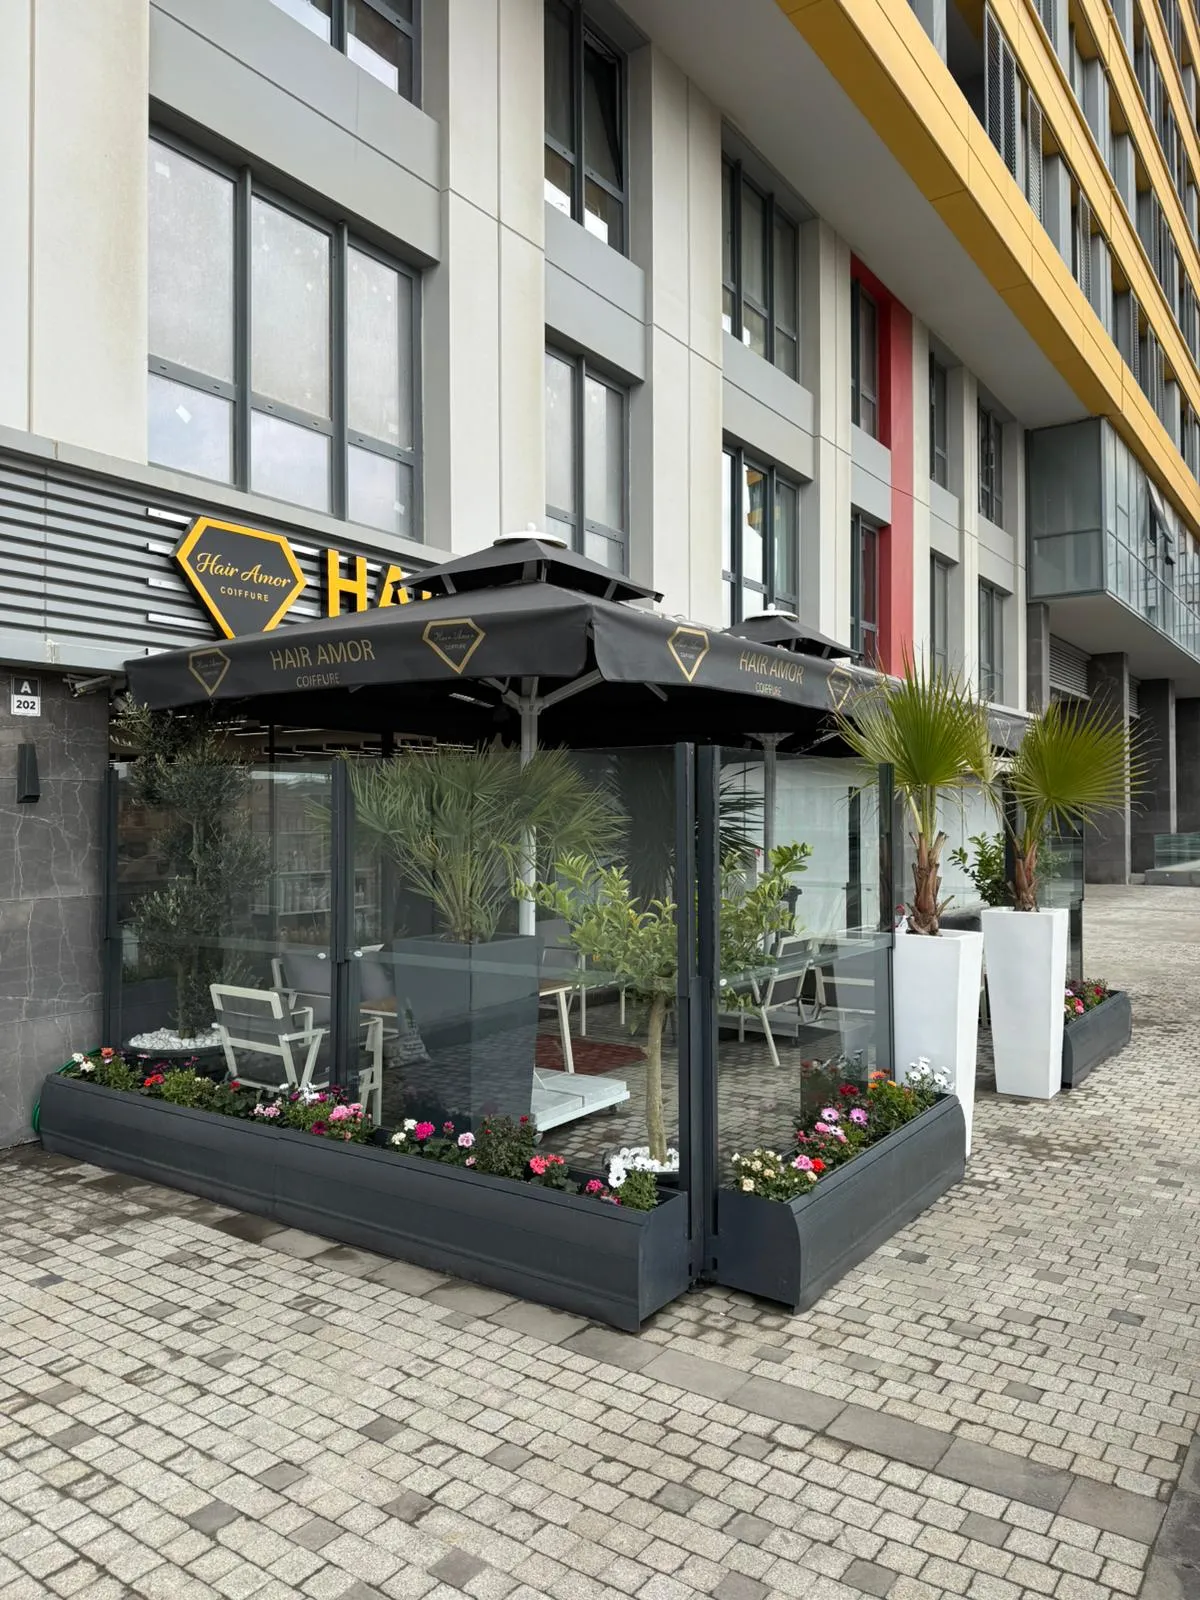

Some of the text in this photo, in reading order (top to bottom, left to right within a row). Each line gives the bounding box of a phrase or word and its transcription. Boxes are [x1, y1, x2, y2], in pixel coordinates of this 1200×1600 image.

[196, 552, 291, 588] Hair Amor
[220, 586, 269, 602] COIFFURE
[327, 548, 432, 618] HA
[269, 639, 376, 671] HAIR AMOR
[739, 650, 804, 685] HAIR AMOR
[20, 680, 32, 694] A
[296, 672, 341, 688] COIFFURE
[15, 699, 36, 710] 202
